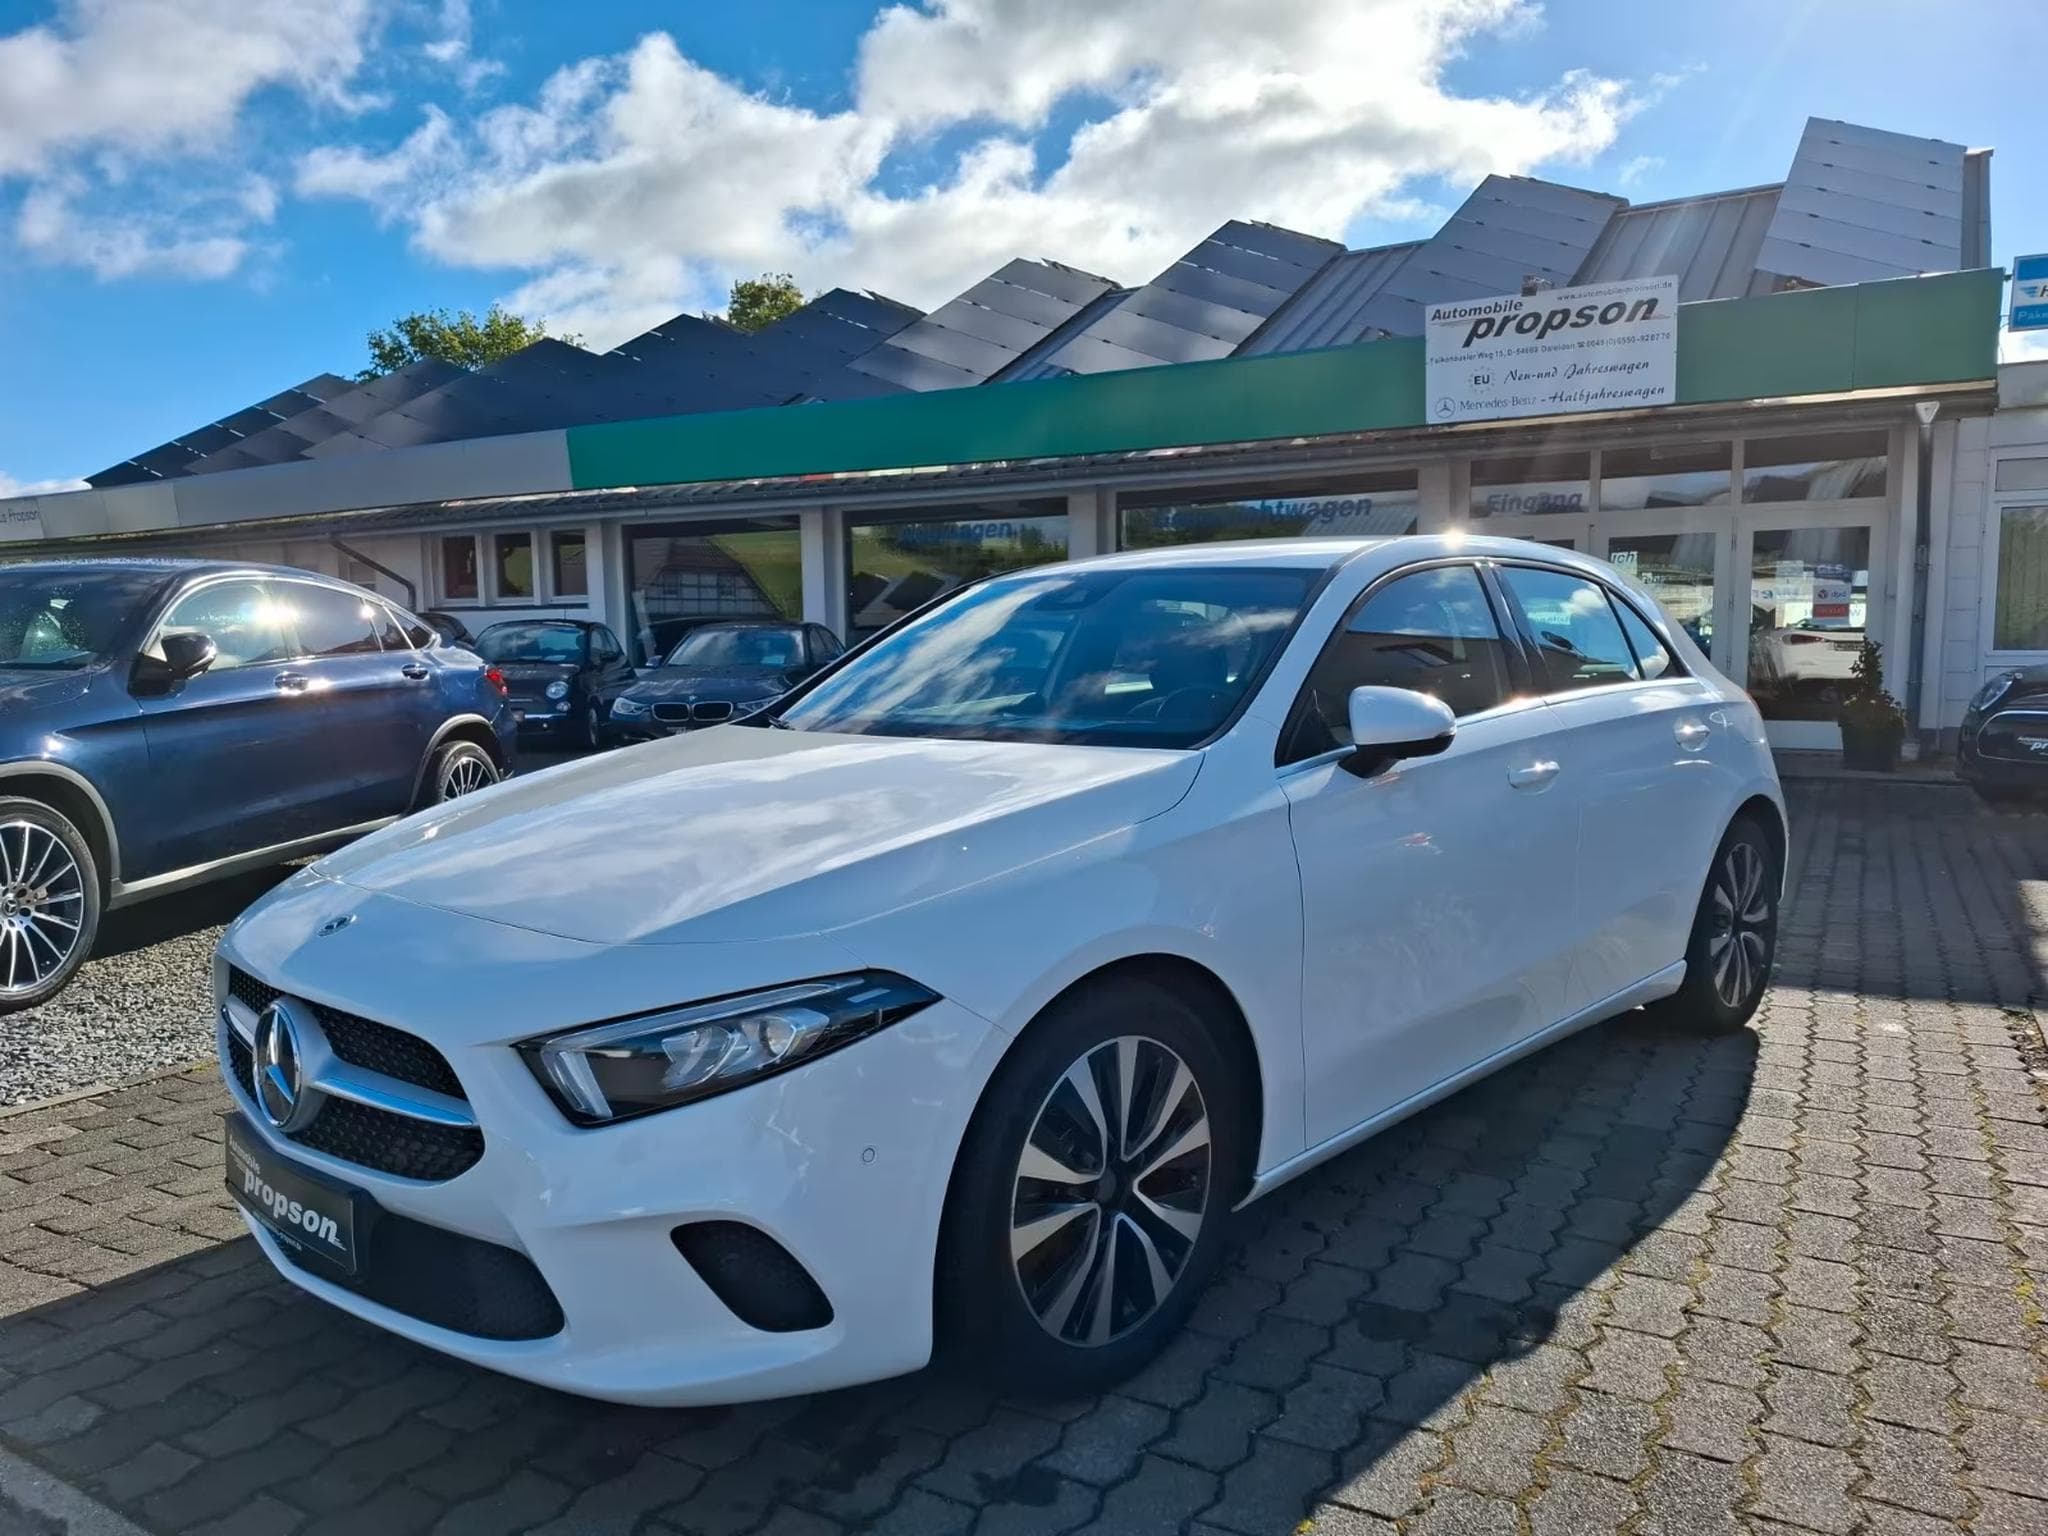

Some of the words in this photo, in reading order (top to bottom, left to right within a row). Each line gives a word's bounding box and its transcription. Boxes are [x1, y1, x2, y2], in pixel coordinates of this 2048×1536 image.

[1431, 300, 1523, 321] Automobile
[1462, 297, 1658, 348] propson
[1474, 374, 1490, 385] EU
[1564, 361, 1649, 380] Jahreswagen
[244, 1166, 338, 1244] propson
